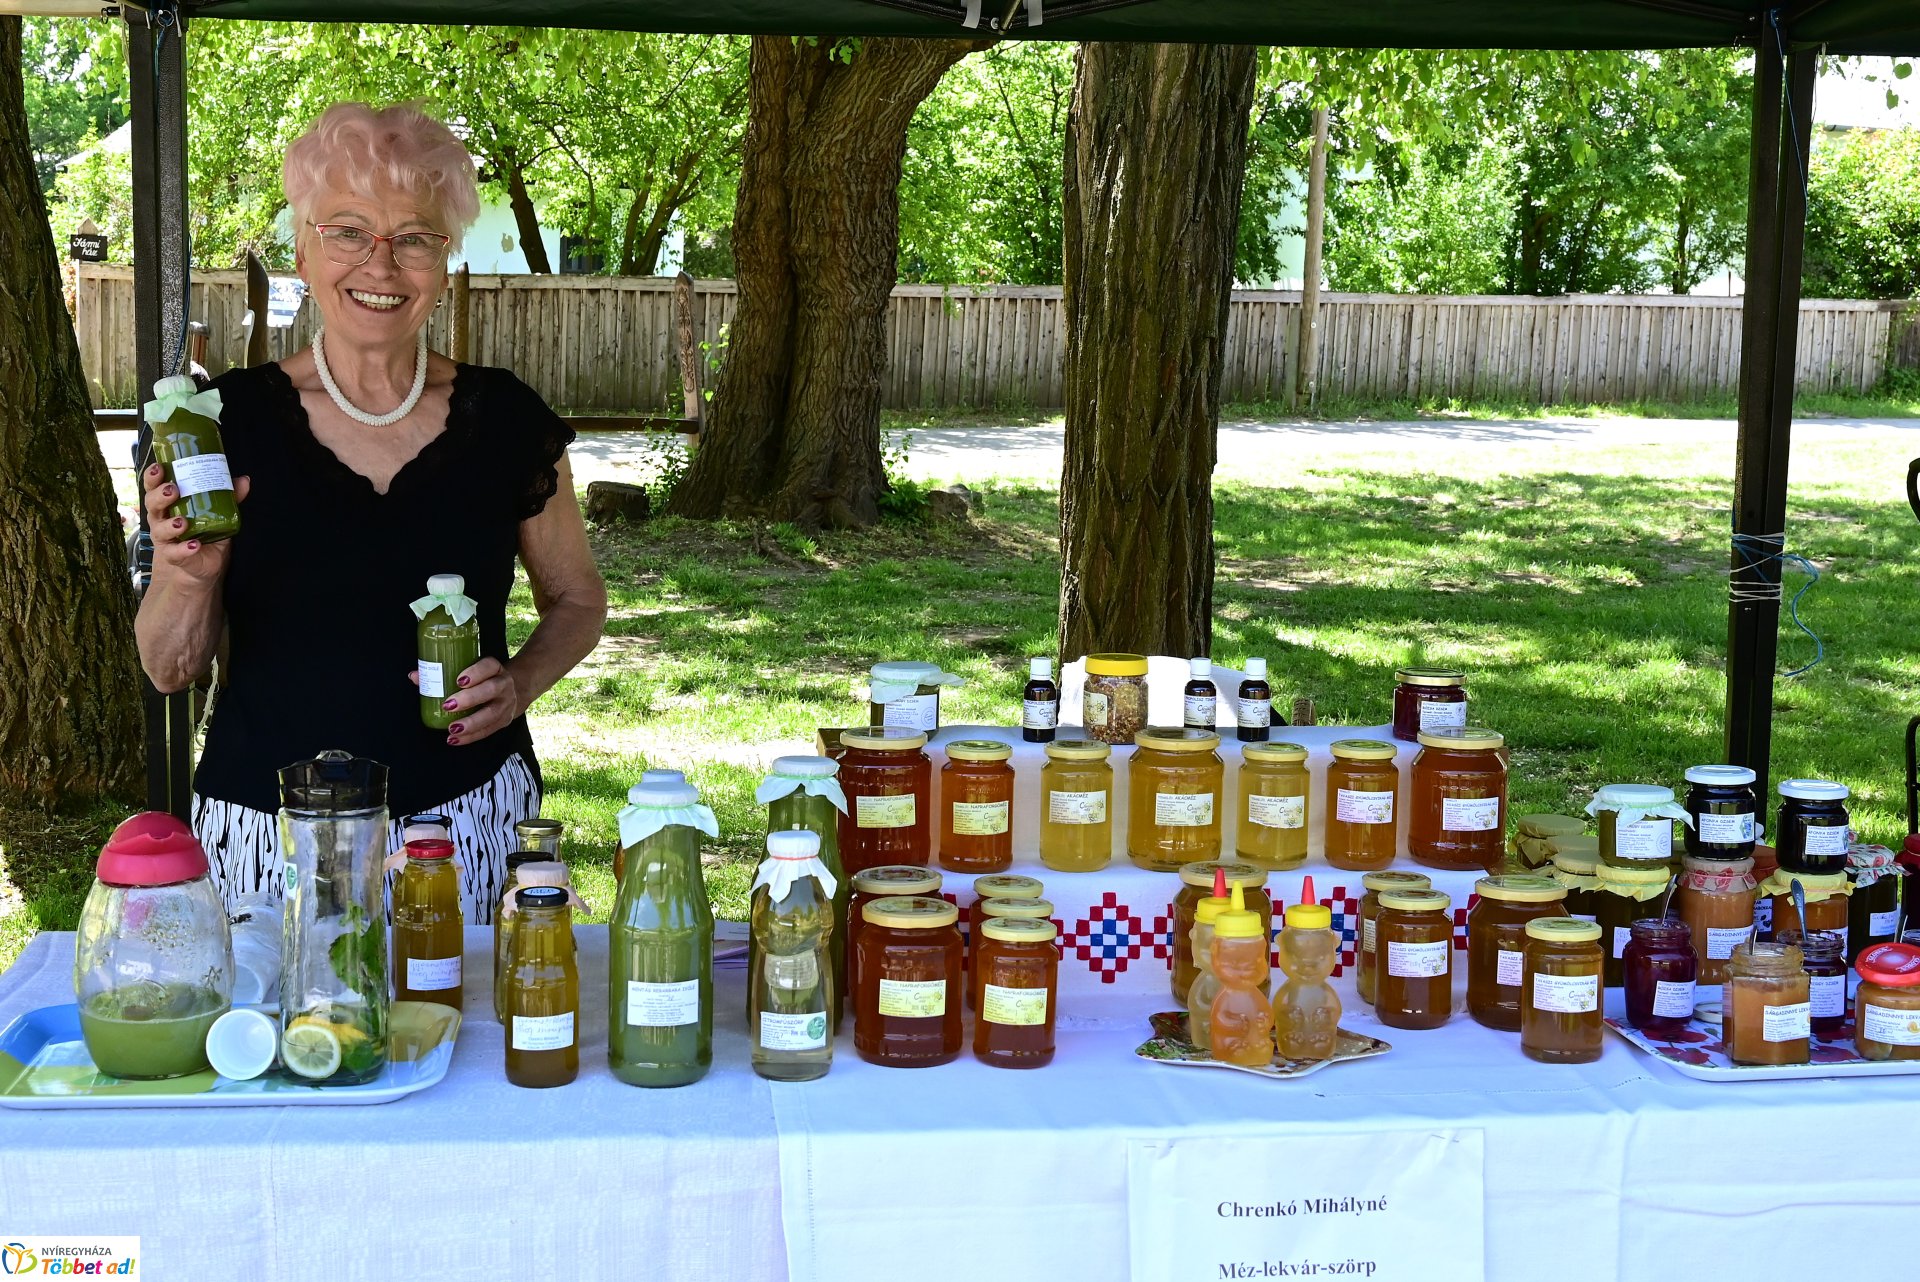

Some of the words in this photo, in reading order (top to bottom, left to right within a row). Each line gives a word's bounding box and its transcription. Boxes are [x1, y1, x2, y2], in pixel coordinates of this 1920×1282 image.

[82, 247, 98, 256] ház
[1866, 1009, 1904, 1020] SÁRGADINNYE
[1216, 1200, 1297, 1218] Chrenkó
[1304, 1195, 1388, 1216] Mihályné
[1218, 1258, 1377, 1279] Méz-lekvár-szörp
